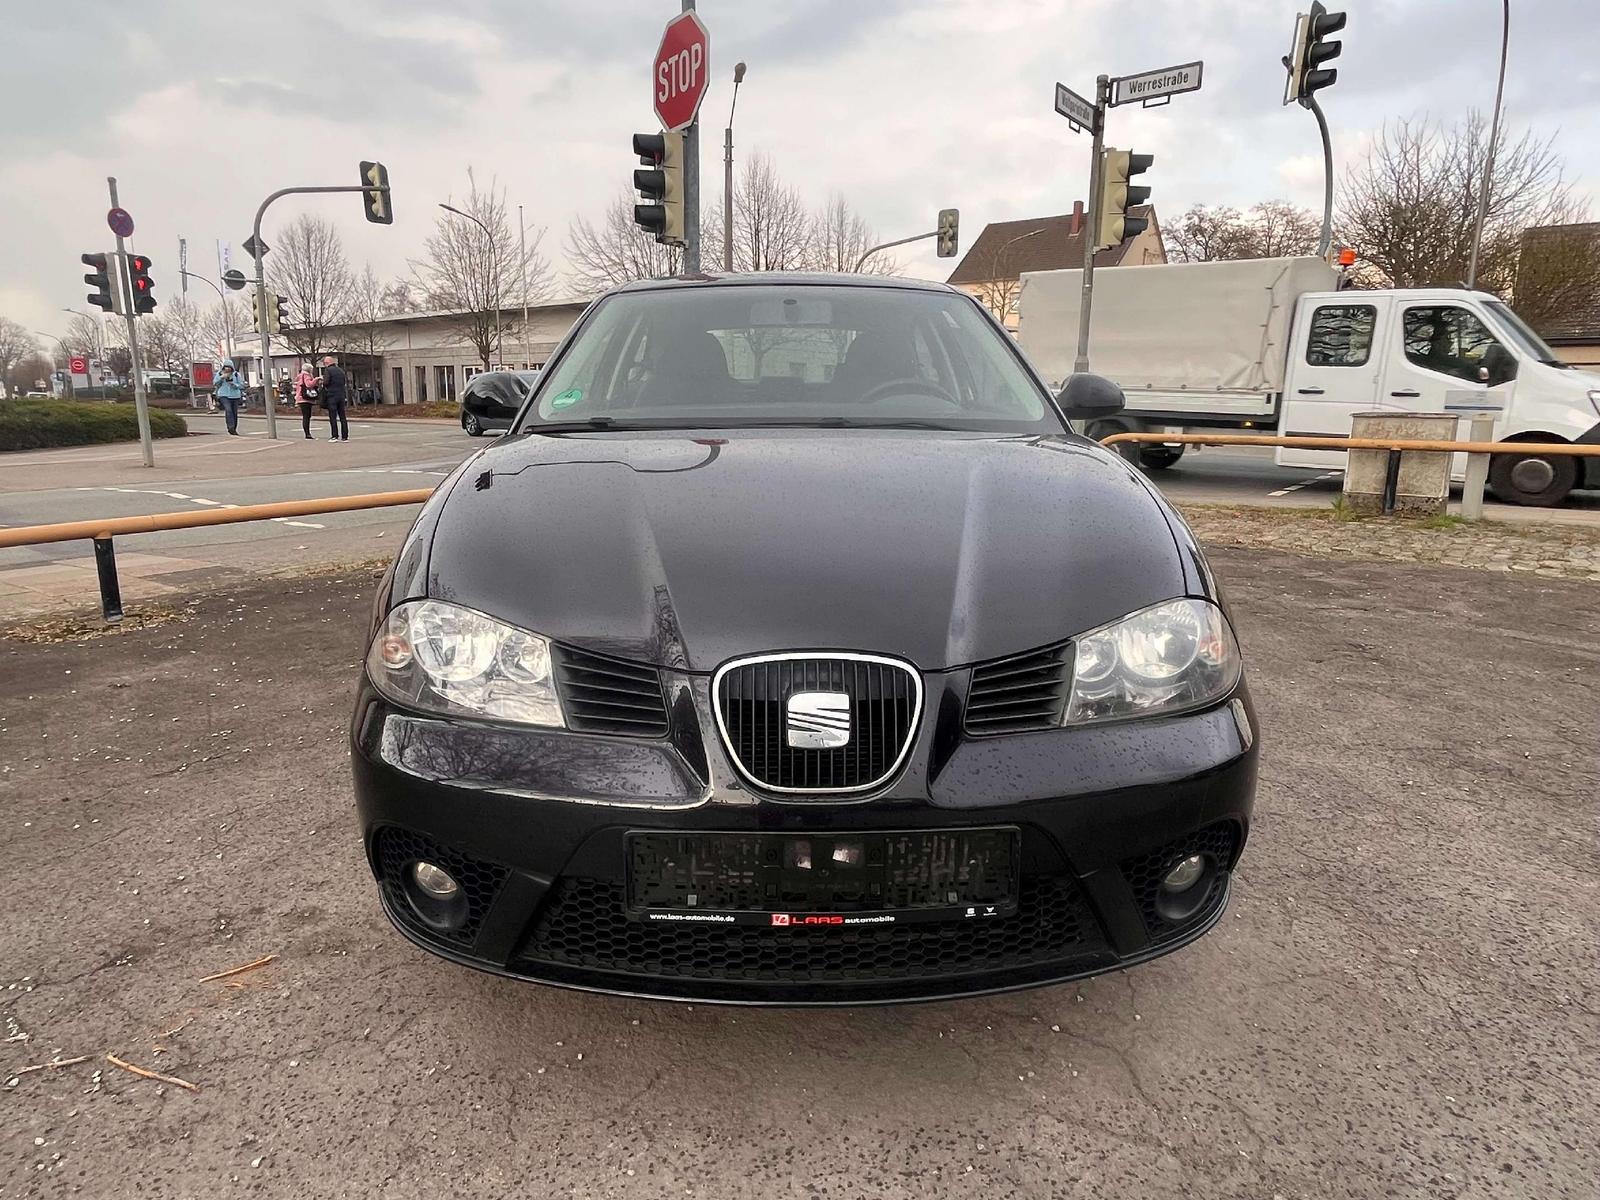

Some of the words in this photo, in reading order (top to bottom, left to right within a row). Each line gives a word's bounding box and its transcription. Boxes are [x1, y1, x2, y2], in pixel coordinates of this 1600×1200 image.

[659, 43, 702, 103] STOP
[1129, 72, 1189, 94] Werrestraße
[649, 913, 735, 923] www.laas-automobile.de
[792, 916, 843, 924] LAAS
[844, 915, 895, 924] automobile
